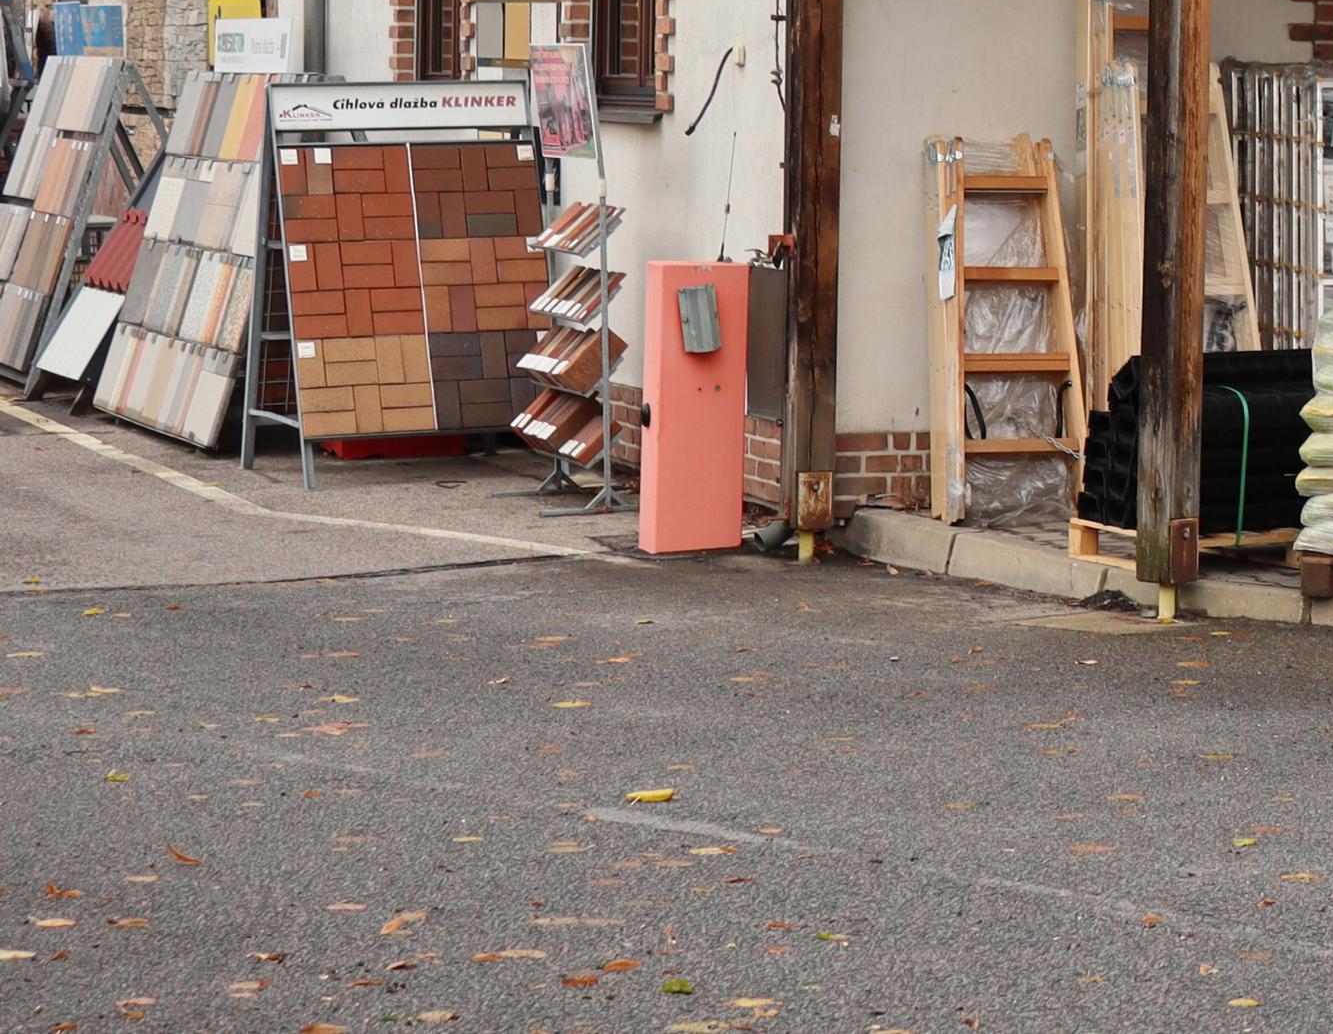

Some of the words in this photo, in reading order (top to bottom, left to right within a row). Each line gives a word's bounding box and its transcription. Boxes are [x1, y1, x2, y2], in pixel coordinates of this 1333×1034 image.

[332, 97, 385, 110] Cihlová
[389, 97, 438, 109] dlažba
[441, 95, 517, 108] KLINKER
